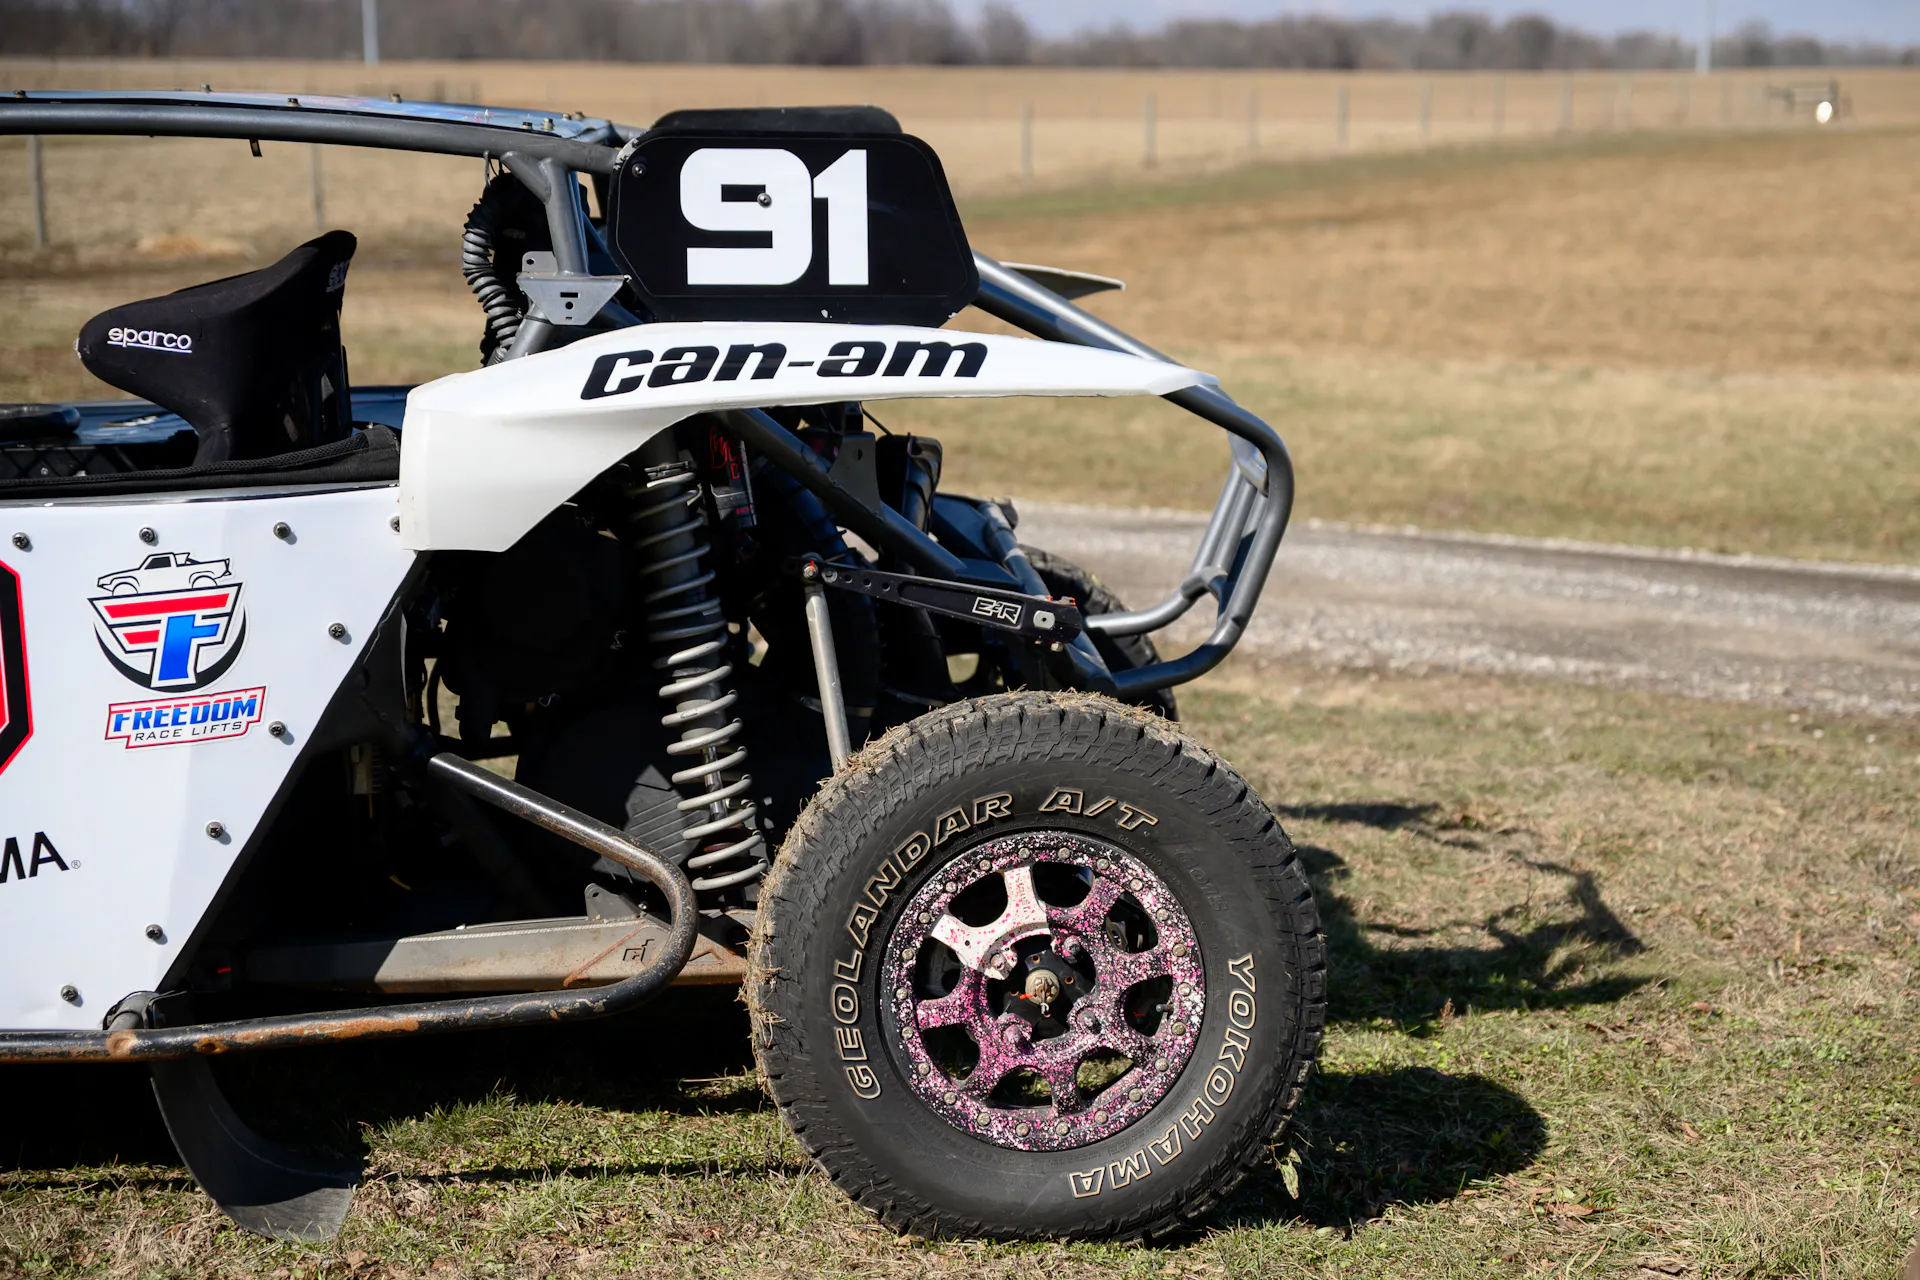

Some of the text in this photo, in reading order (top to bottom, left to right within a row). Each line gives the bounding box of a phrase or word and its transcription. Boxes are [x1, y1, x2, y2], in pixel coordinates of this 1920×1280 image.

[679, 147, 870, 286] 91
[107, 326, 192, 353] sparco
[580, 340, 988, 400] can-am
[110, 694, 258, 732] FREEDOM
[134, 720, 242, 742] RACE LIFTS
[830, 792, 1013, 1099] GEOLANDAR
[1038, 788, 1160, 832] A/T
[1069, 952, 1256, 1199] YOKOHAMA
